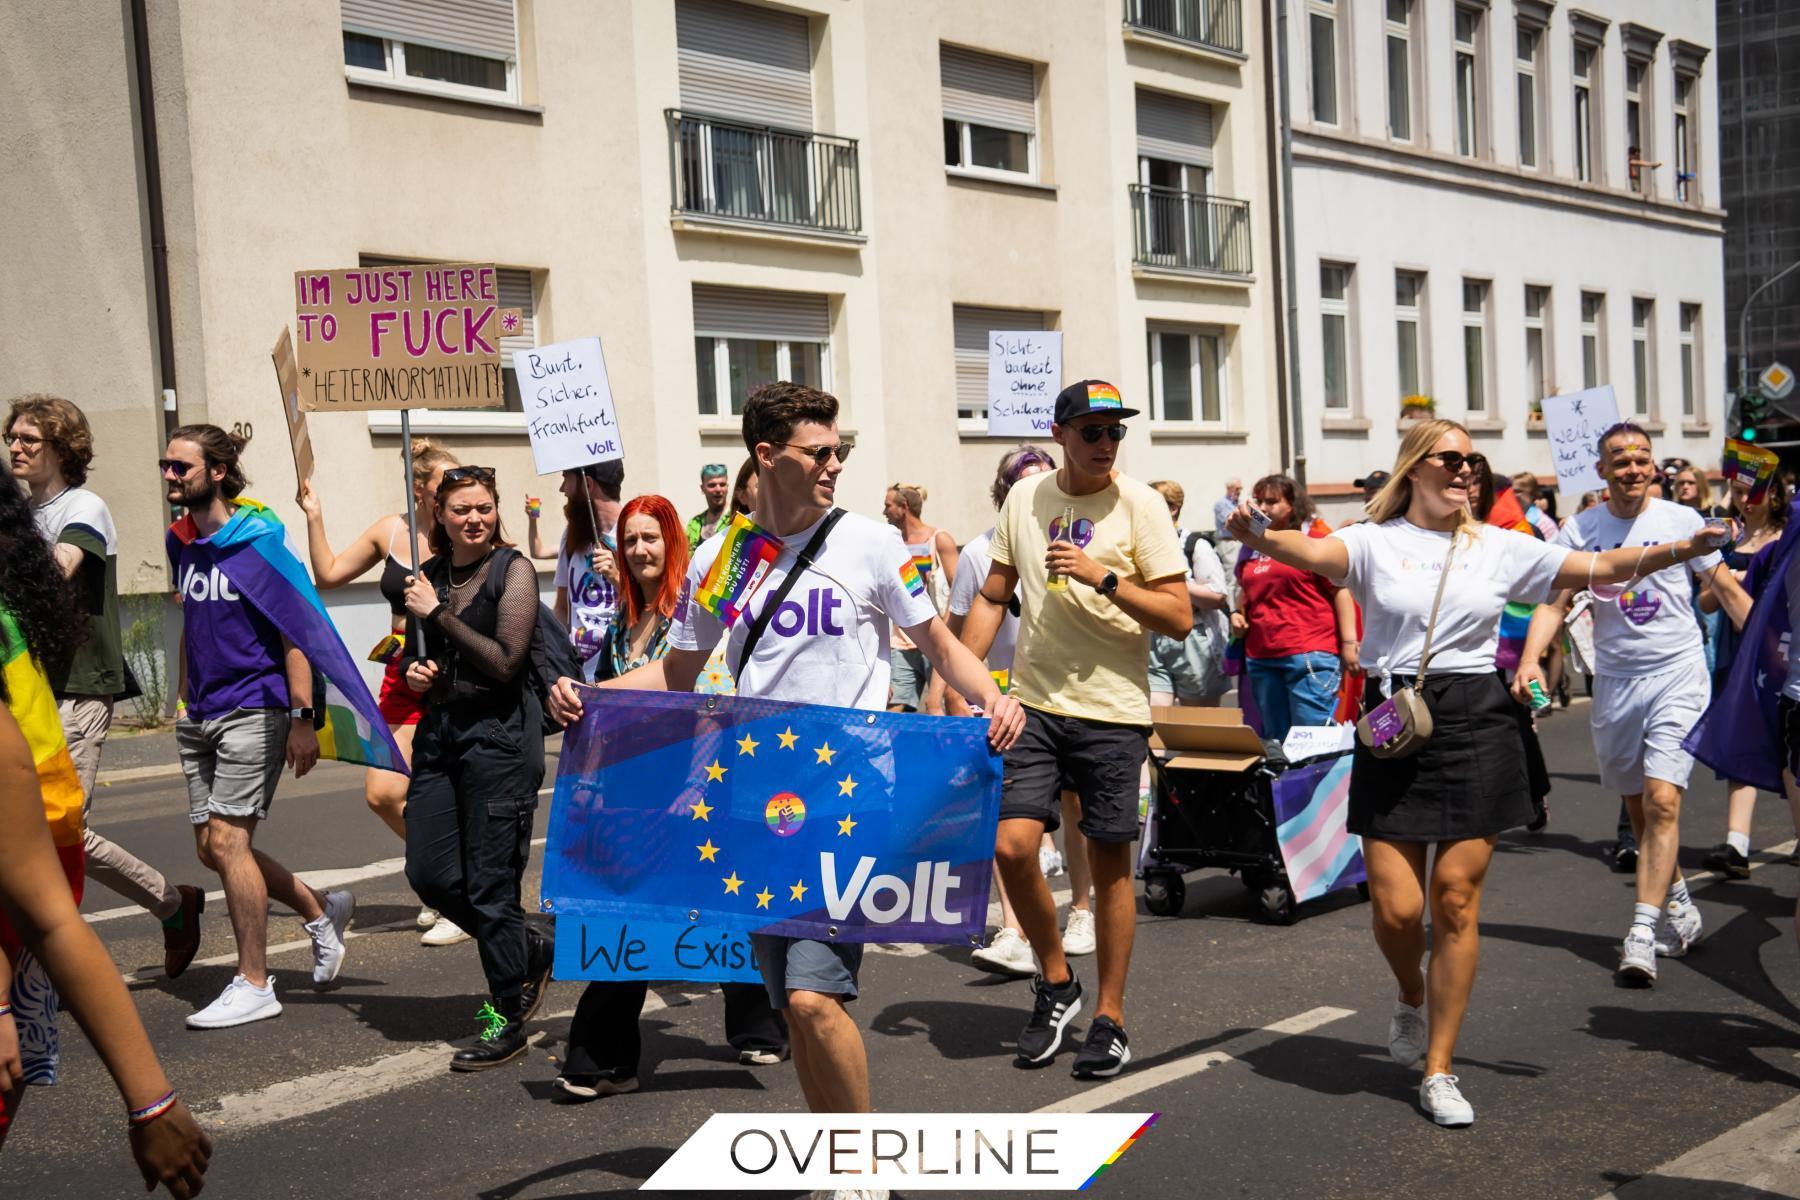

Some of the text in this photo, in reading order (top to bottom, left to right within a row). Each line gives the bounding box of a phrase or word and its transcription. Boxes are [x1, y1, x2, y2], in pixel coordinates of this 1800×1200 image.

[299, 268, 497, 306] IM JUST HERE
[298, 305, 498, 358] TO FUCK
[528, 352, 582, 379] Bunt.
[535, 382, 597, 408] Sicher.
[1011, 378, 1045, 392] ohne
[530, 408, 615, 439] Frankfurt.
[586, 440, 616, 456] Volt
[711, 541, 742, 593] WILLKOMMEN
[725, 557, 743, 586] SO WIE
[570, 567, 618, 609] Vol
[729, 581, 738, 593] DU
[820, 852, 962, 925] Volt
[581, 923, 649, 973] We
